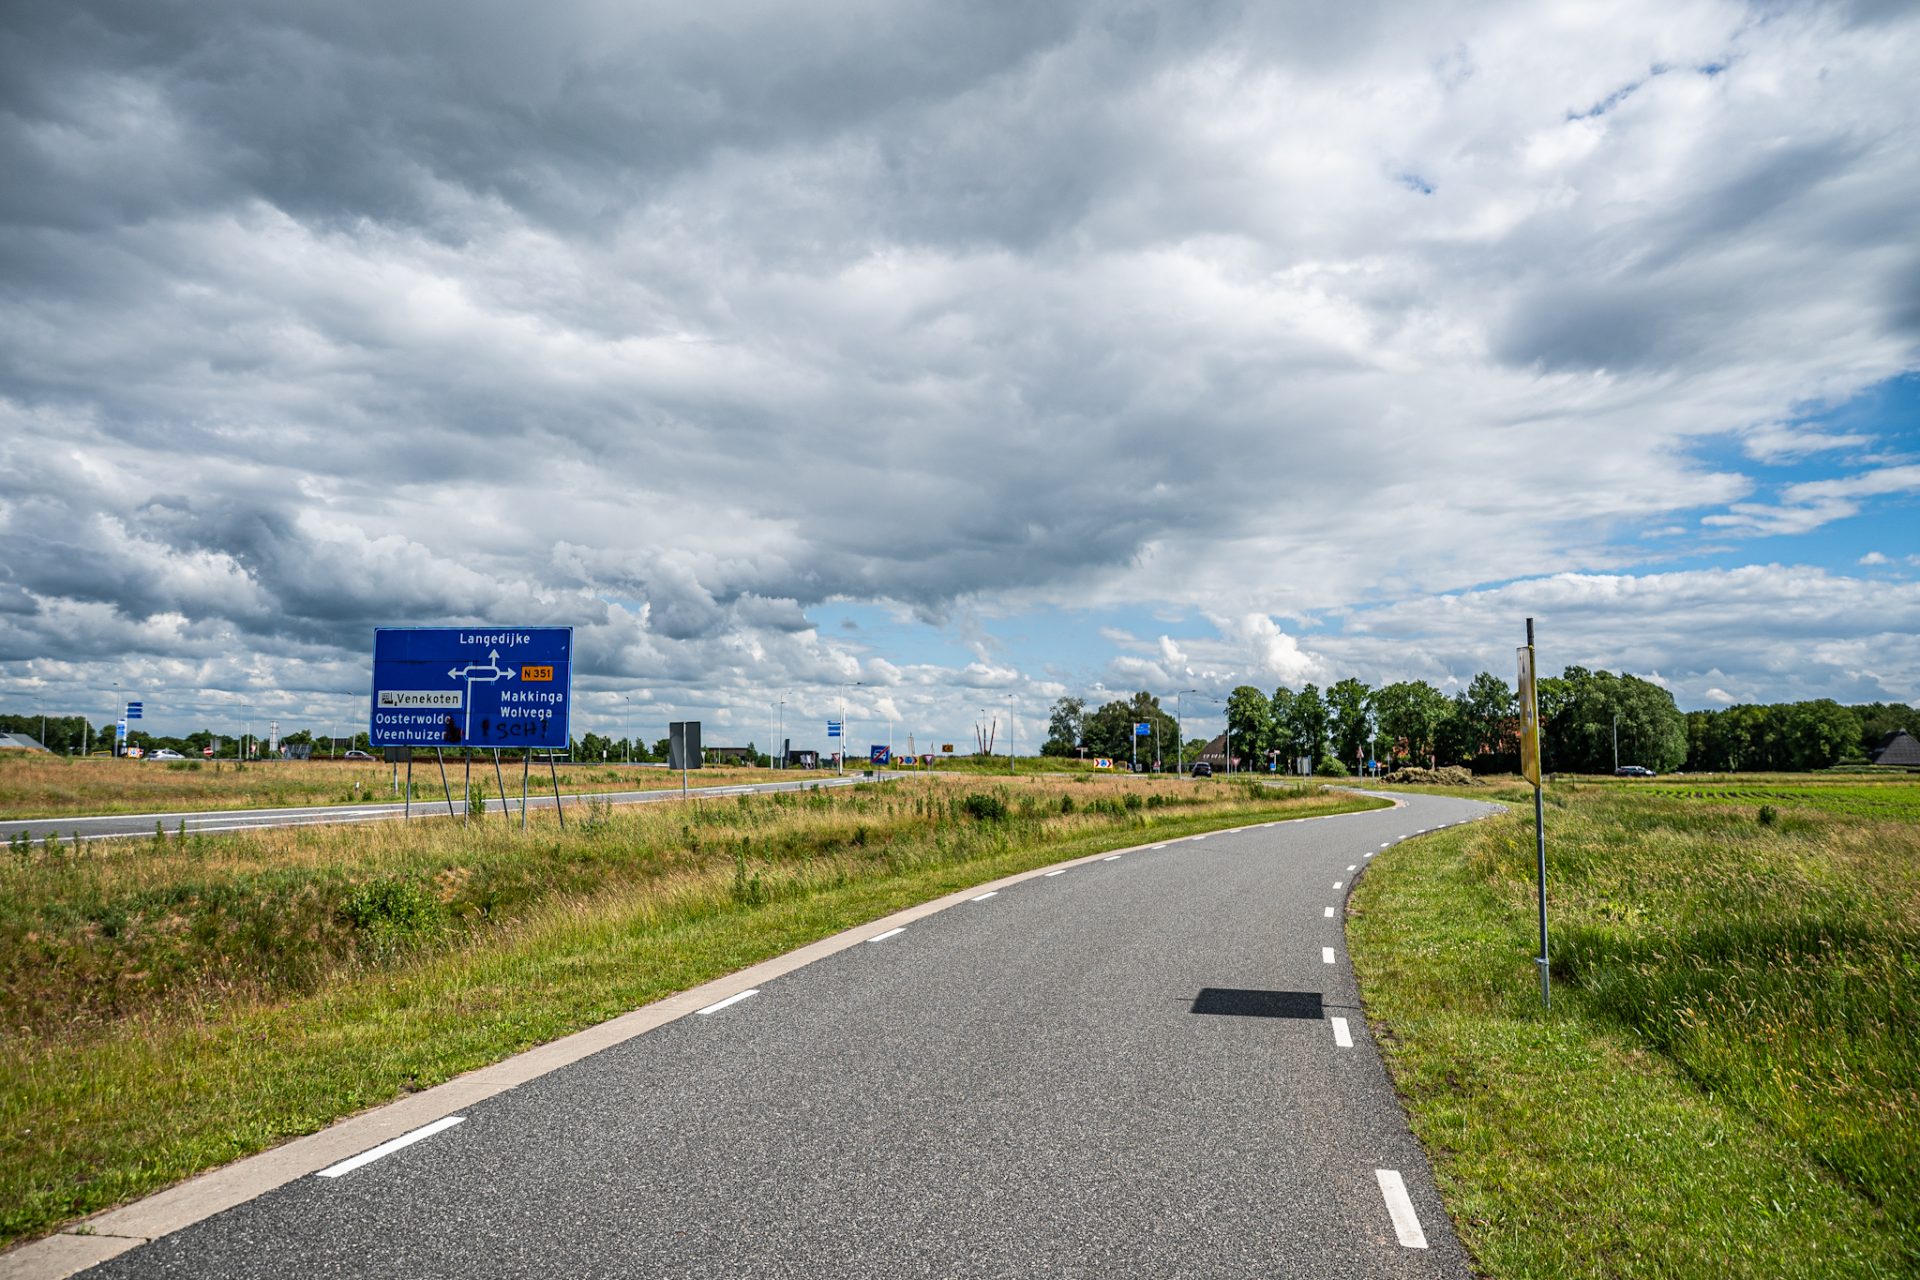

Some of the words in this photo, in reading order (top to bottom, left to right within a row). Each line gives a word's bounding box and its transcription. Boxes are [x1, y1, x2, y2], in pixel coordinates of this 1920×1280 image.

[459, 633, 531, 647] Langedijke
[524, 669, 531, 678] N
[533, 669, 551, 678] 351
[397, 693, 459, 704] Venekoten
[501, 691, 563, 705] Makkinga
[500, 706, 552, 721] Wolvega
